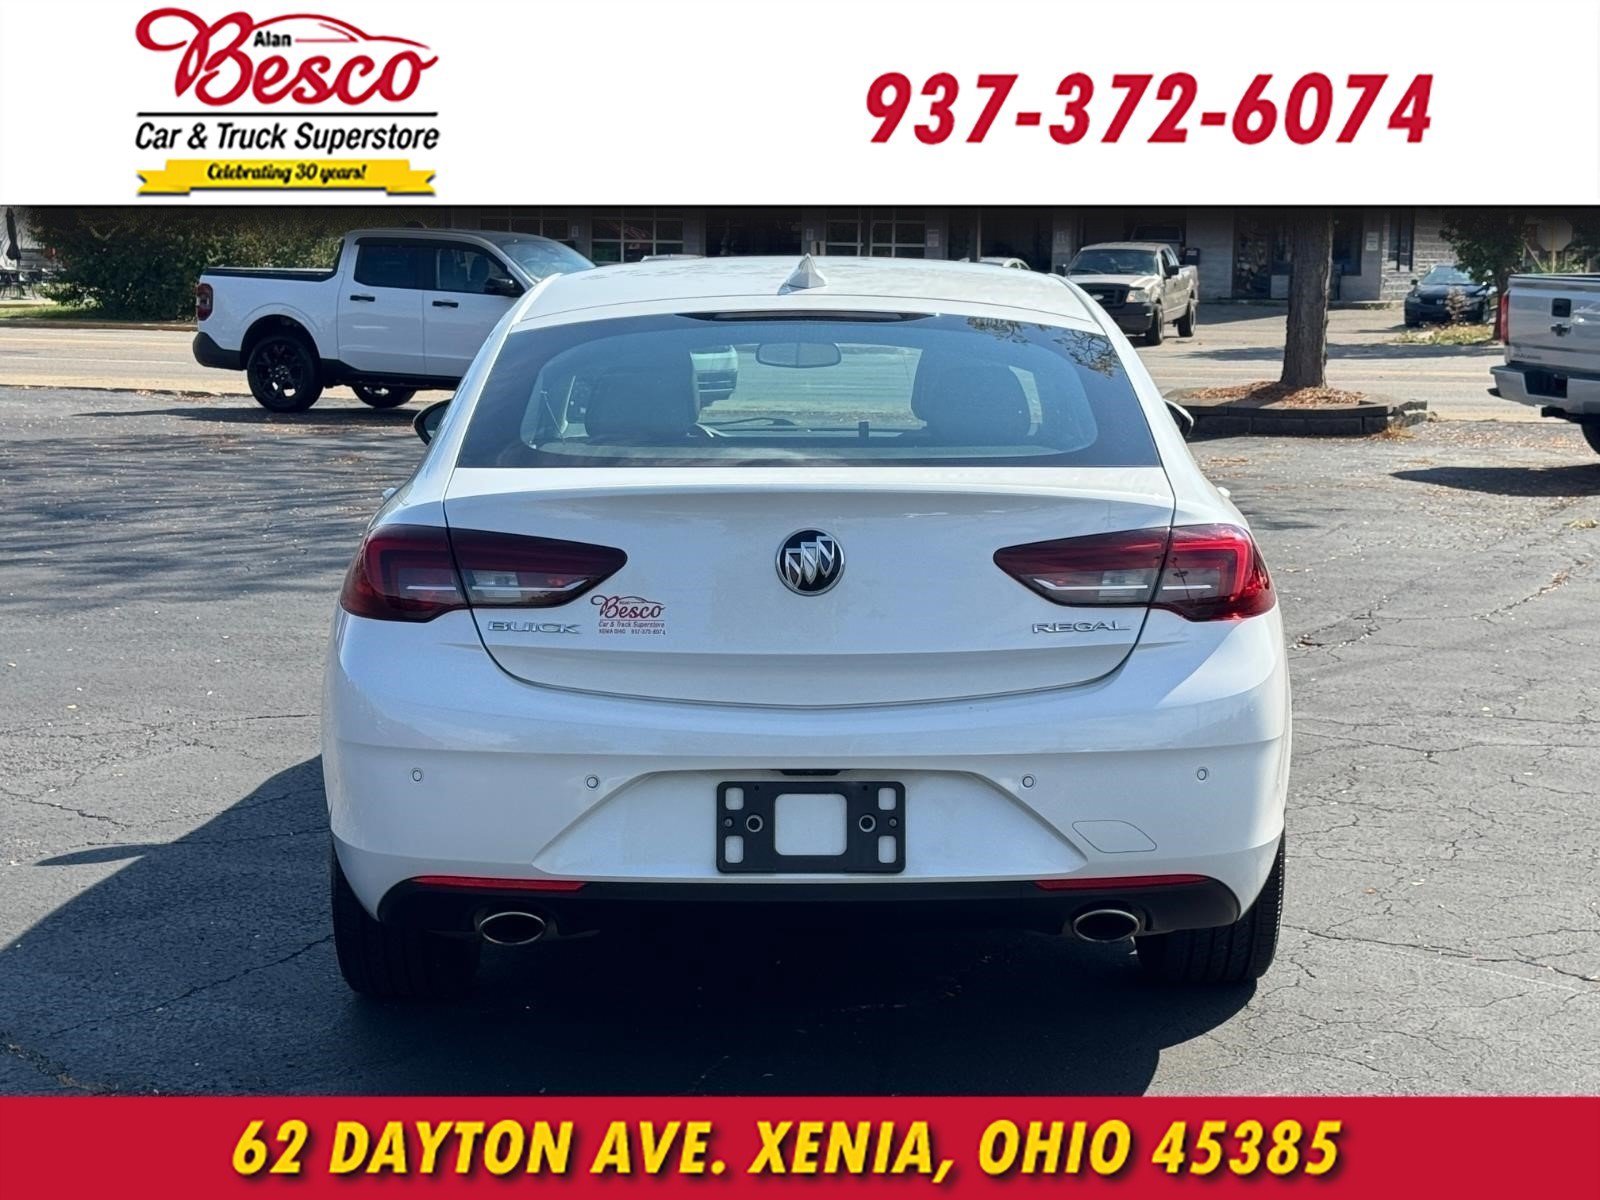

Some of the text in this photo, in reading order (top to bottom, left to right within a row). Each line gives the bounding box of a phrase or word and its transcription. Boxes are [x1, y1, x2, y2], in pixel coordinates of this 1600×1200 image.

[590, 594, 666, 618] Besco
[487, 620, 582, 635] BUICK
[1032, 620, 1131, 634] REGAL
